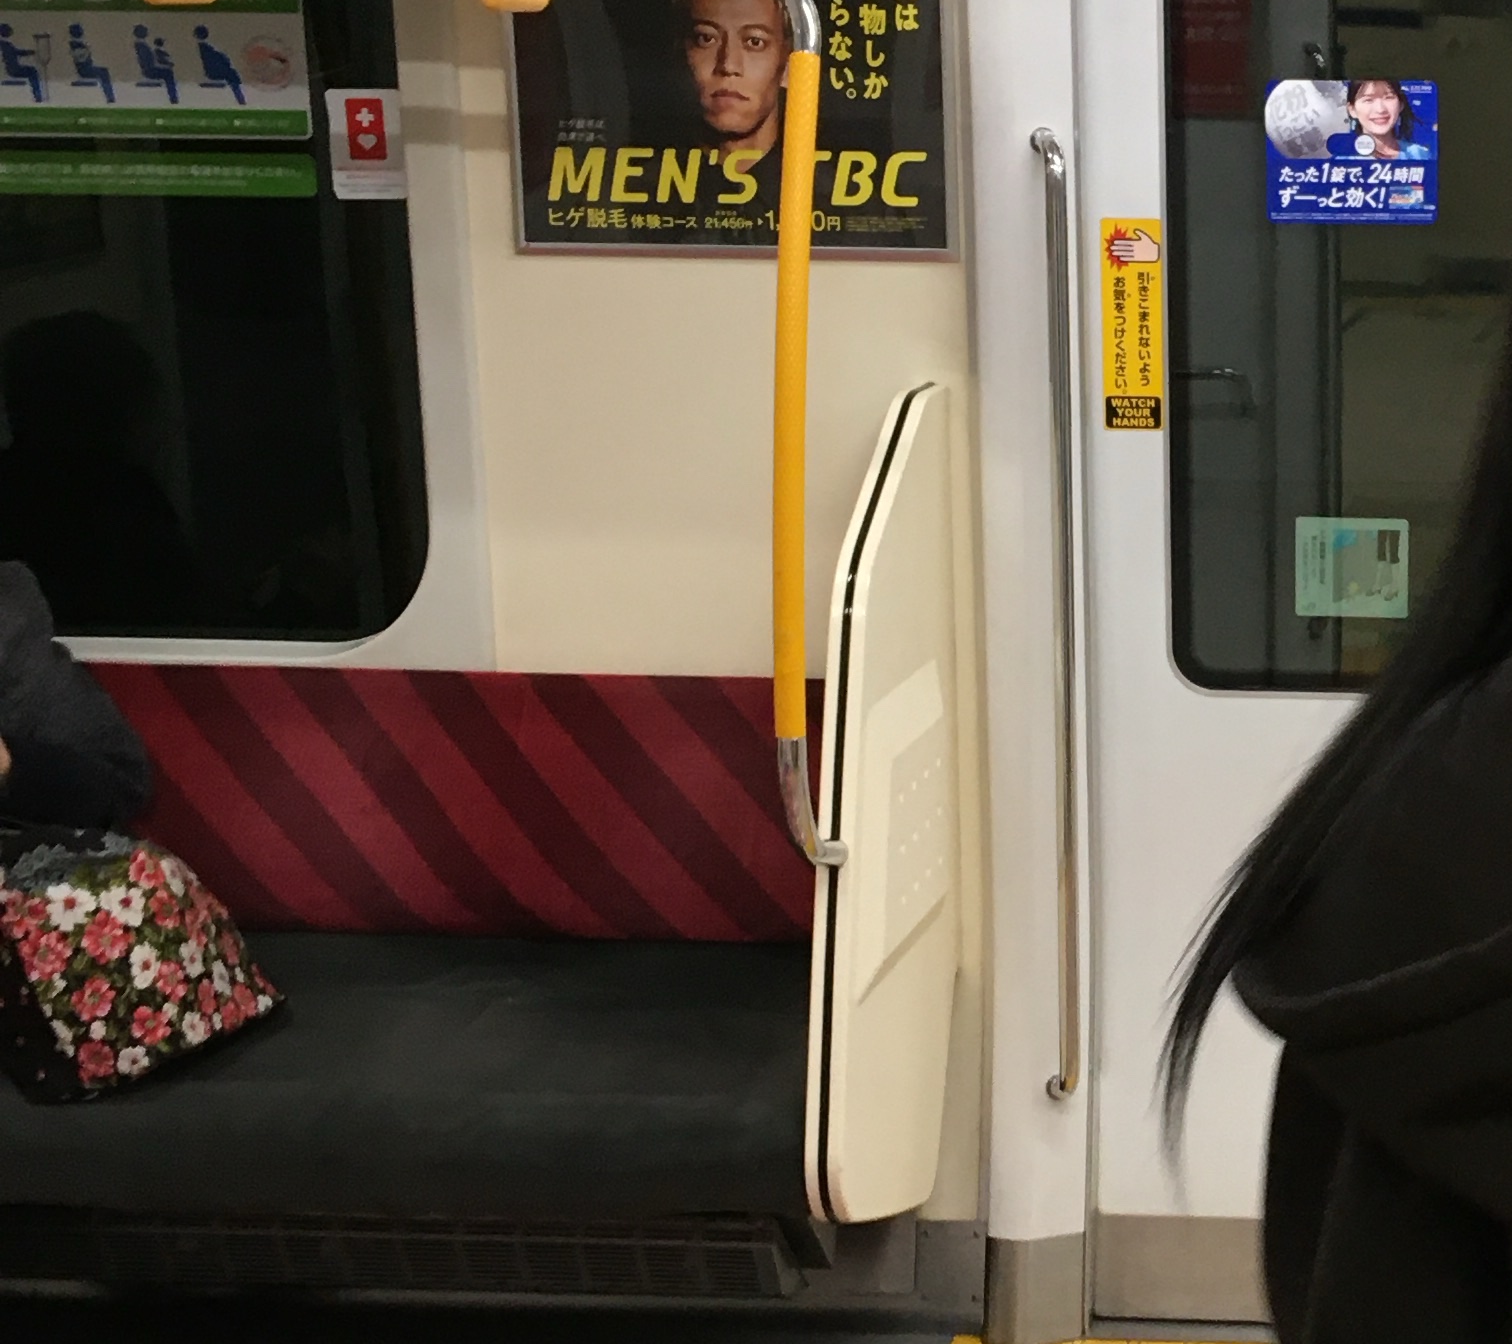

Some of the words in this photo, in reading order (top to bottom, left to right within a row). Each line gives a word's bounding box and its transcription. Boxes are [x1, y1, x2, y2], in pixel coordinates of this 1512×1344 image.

[548, 147, 768, 206] MEN'S
[548, 208, 628, 230] ヒゲ脱毛
[631, 213, 698, 230] 体験コース
[764, 210, 841, 232] 1,0円
[1110, 398, 1156, 408] WATCH
[1116, 408, 1151, 417] YOUR
[1112, 417, 1155, 427] HANDS
